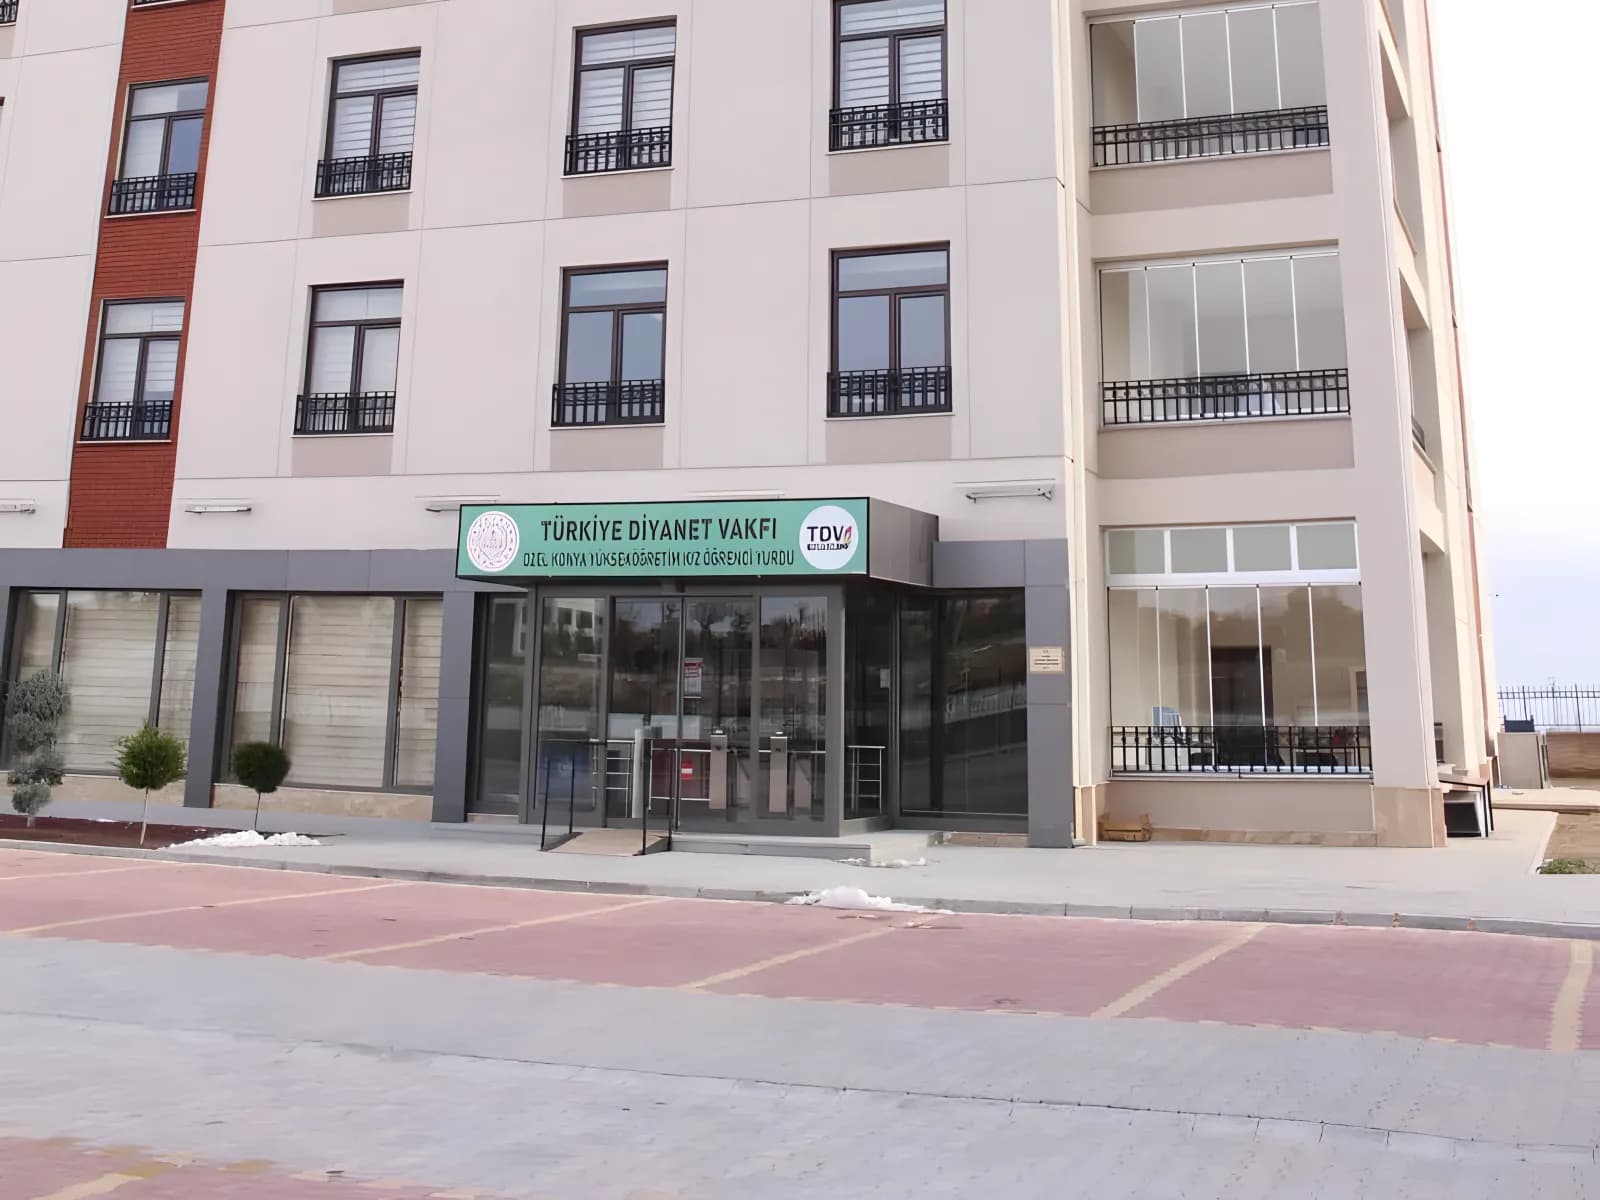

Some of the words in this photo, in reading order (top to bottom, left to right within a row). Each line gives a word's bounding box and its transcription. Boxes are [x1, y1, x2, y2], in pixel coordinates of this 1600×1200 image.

[541, 514, 622, 541] TÜRKİYE
[629, 513, 712, 541] DİYANET
[718, 517, 777, 540] VAKFI
[807, 525, 844, 542] TDV
